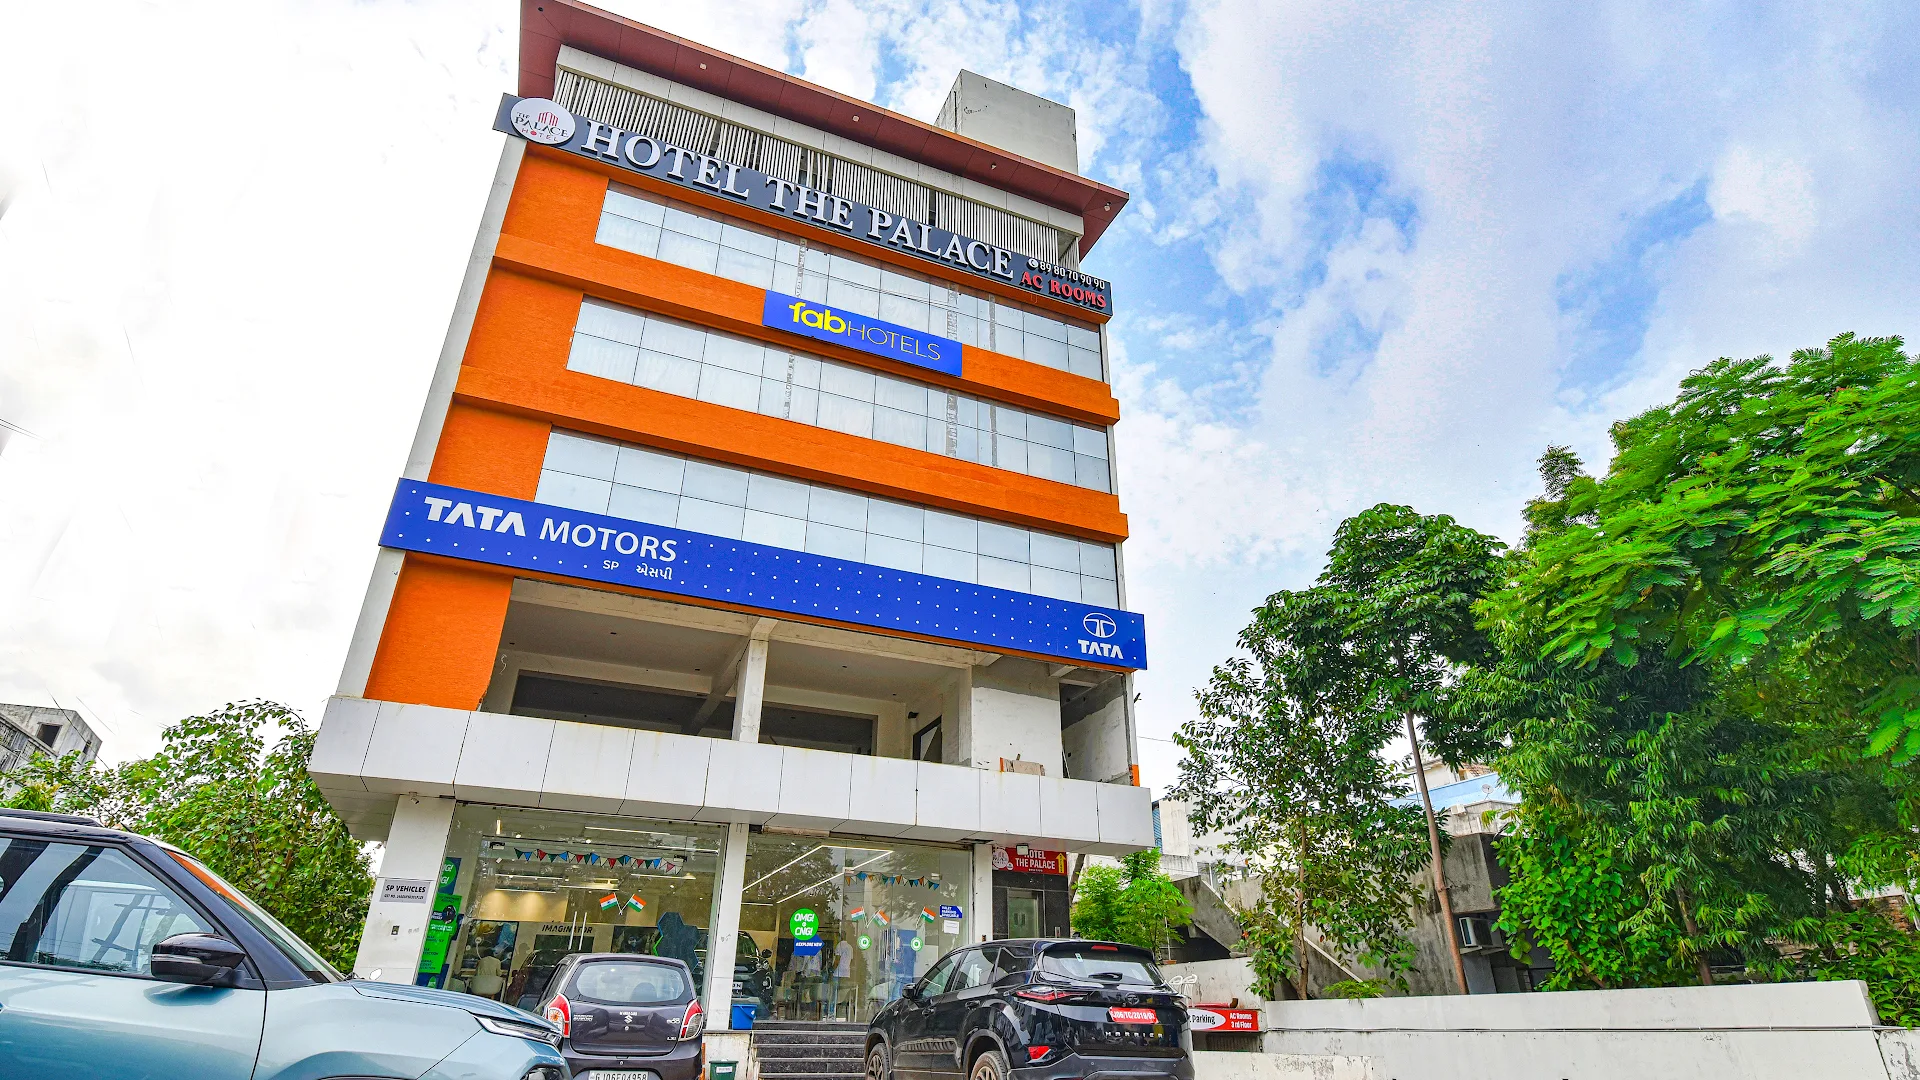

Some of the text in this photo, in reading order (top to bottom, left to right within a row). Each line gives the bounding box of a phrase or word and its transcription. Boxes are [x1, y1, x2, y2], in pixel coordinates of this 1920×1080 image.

[515, 117, 568, 137] PALACE
[581, 120, 1014, 279] HOTEL THE PALACE
[1040, 261, 1105, 290] 89 80 70 90 90
[1021, 271, 1107, 308] AC ROOMS
[424, 496, 677, 562] TATA MOTORS
[603, 560, 619, 571] SP
[636, 562, 673, 580] એસપી
[1078, 639, 1124, 660] TATA
[1015, 857, 1029, 868] THE
[1029, 859, 1056, 870] PALACE
[385, 884, 426, 893] SP VEHICLES
[794, 913, 815, 922] OMG!
[795, 927, 814, 936] CNG!
[1192, 1015, 1216, 1025] Parking
